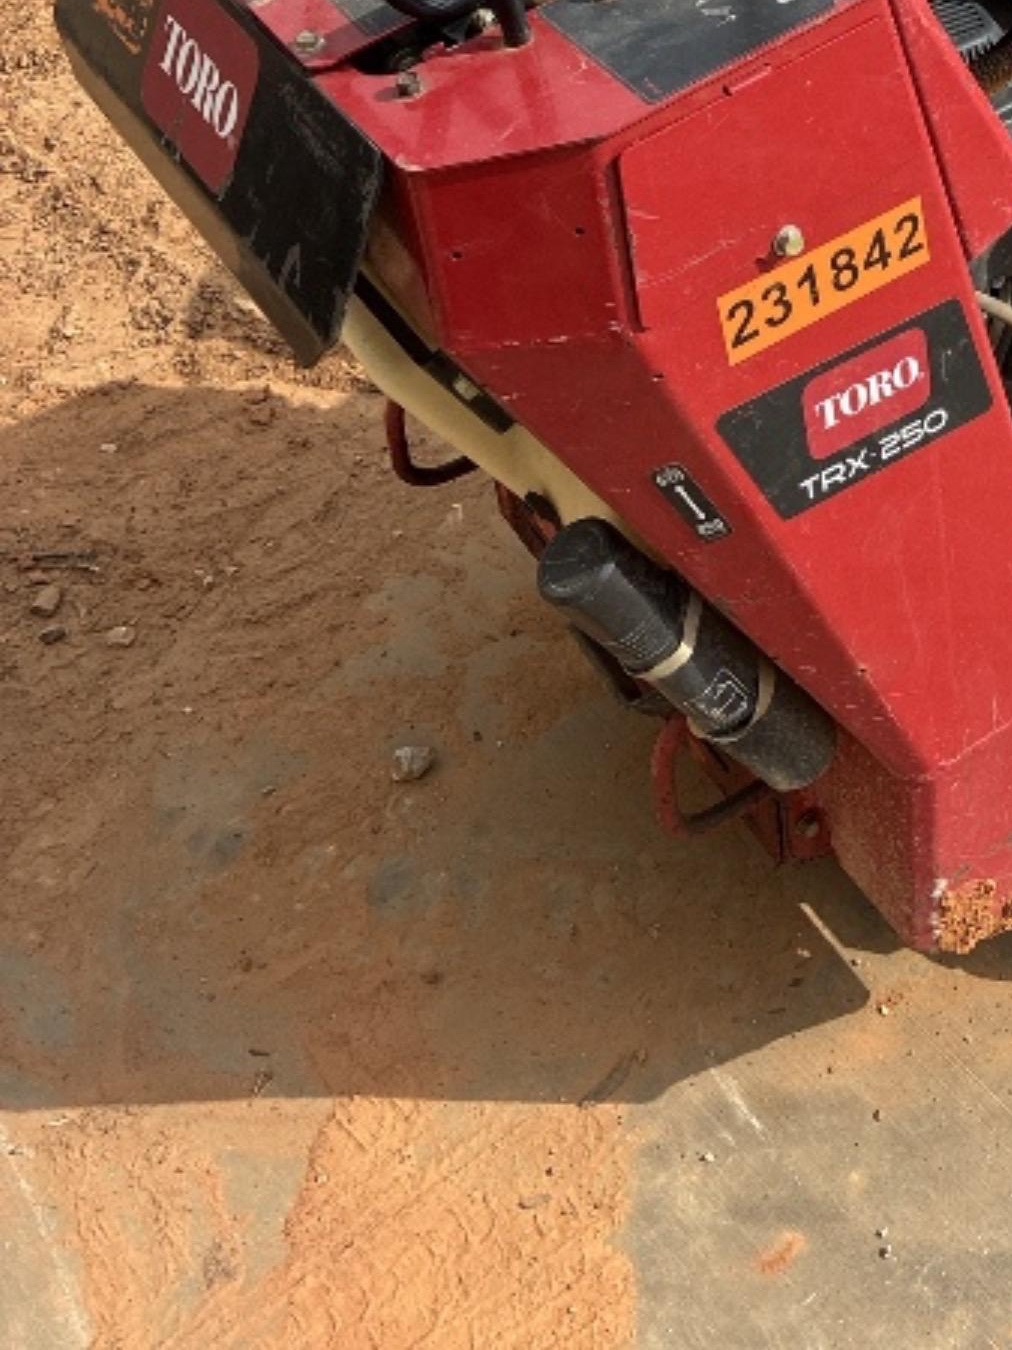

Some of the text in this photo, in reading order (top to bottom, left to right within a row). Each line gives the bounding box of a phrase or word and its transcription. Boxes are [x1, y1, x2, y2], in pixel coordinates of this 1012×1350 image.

[158, 13, 239, 139] TORO
[726, 212, 925, 349] 231842
[814, 355, 921, 430] TORO
[799, 407, 949, 500] TRX-250
